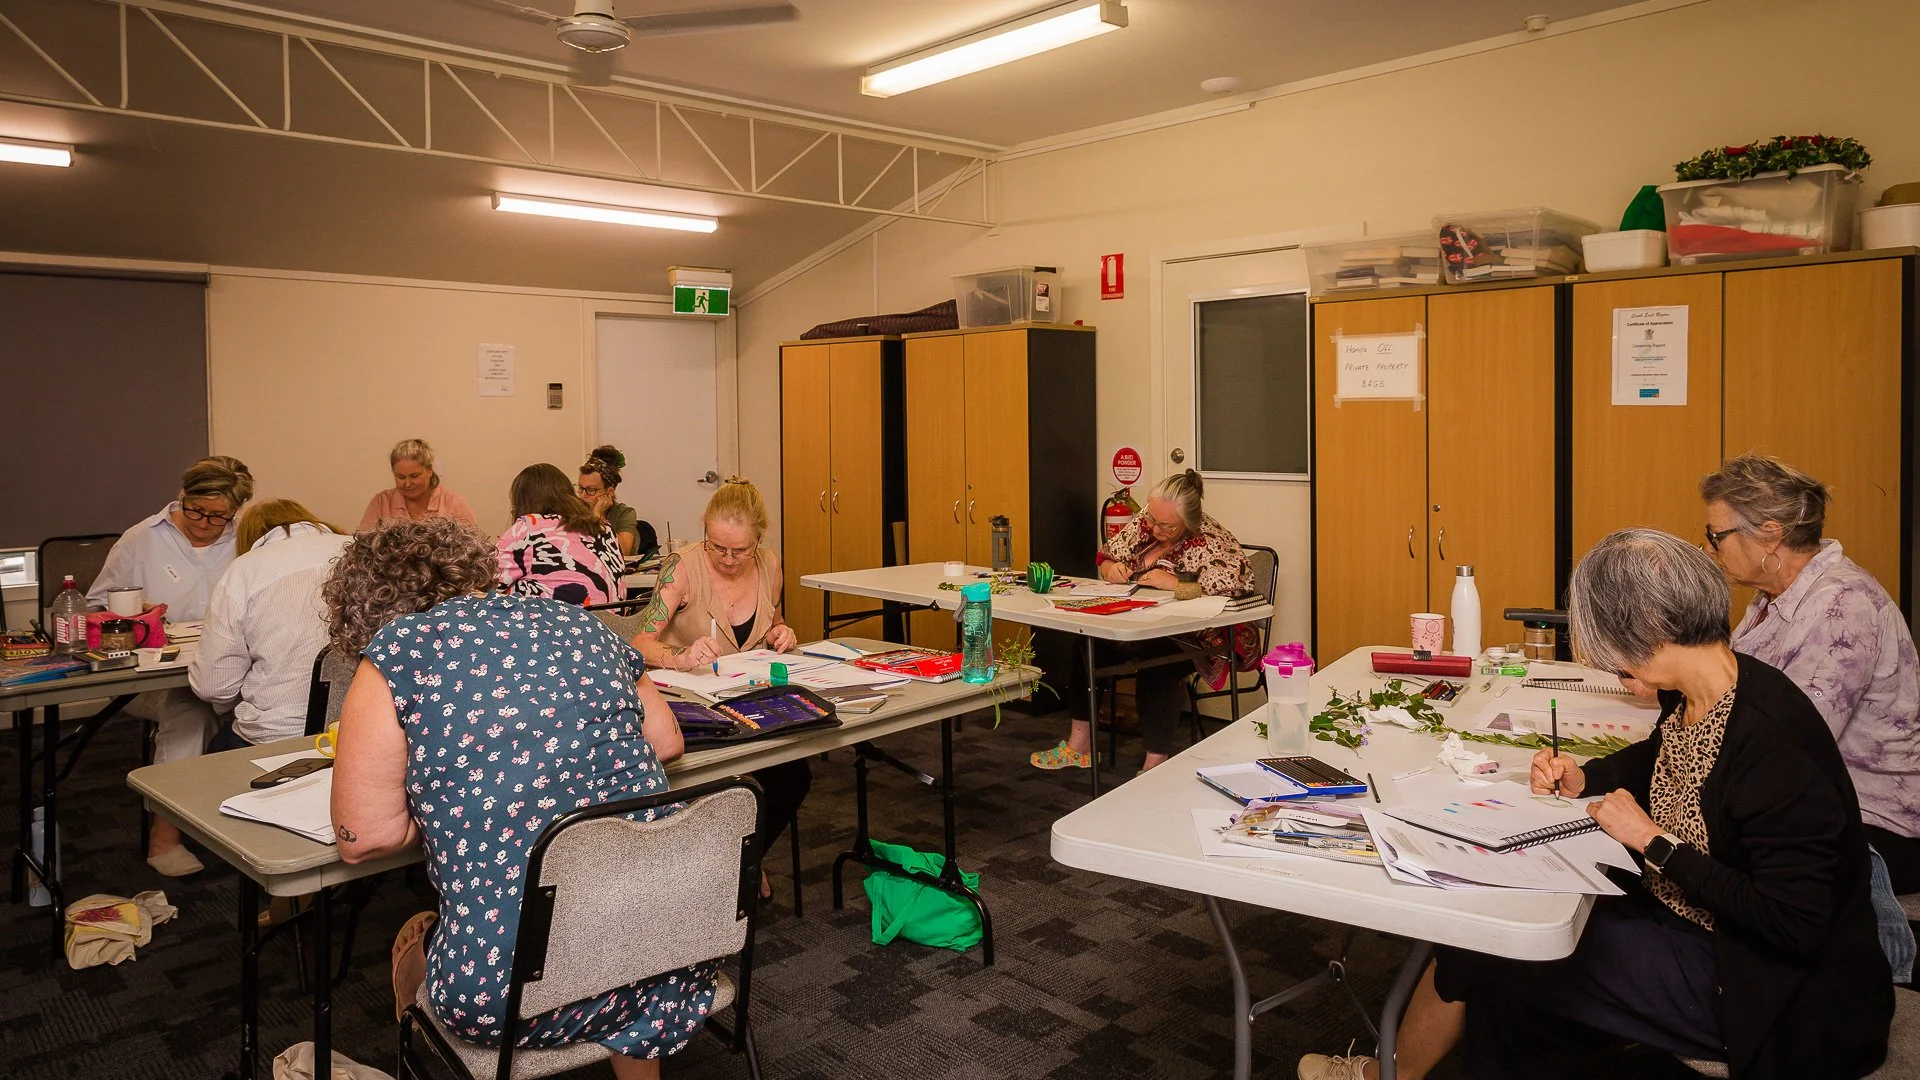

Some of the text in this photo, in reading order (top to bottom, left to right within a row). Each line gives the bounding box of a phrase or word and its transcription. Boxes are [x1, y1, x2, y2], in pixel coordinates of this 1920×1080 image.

[1345, 343, 1393, 353] Hands Off
[1344, 362, 1409, 371] PRIVATE PROPERTY
[56, 616, 70, 644] pump
